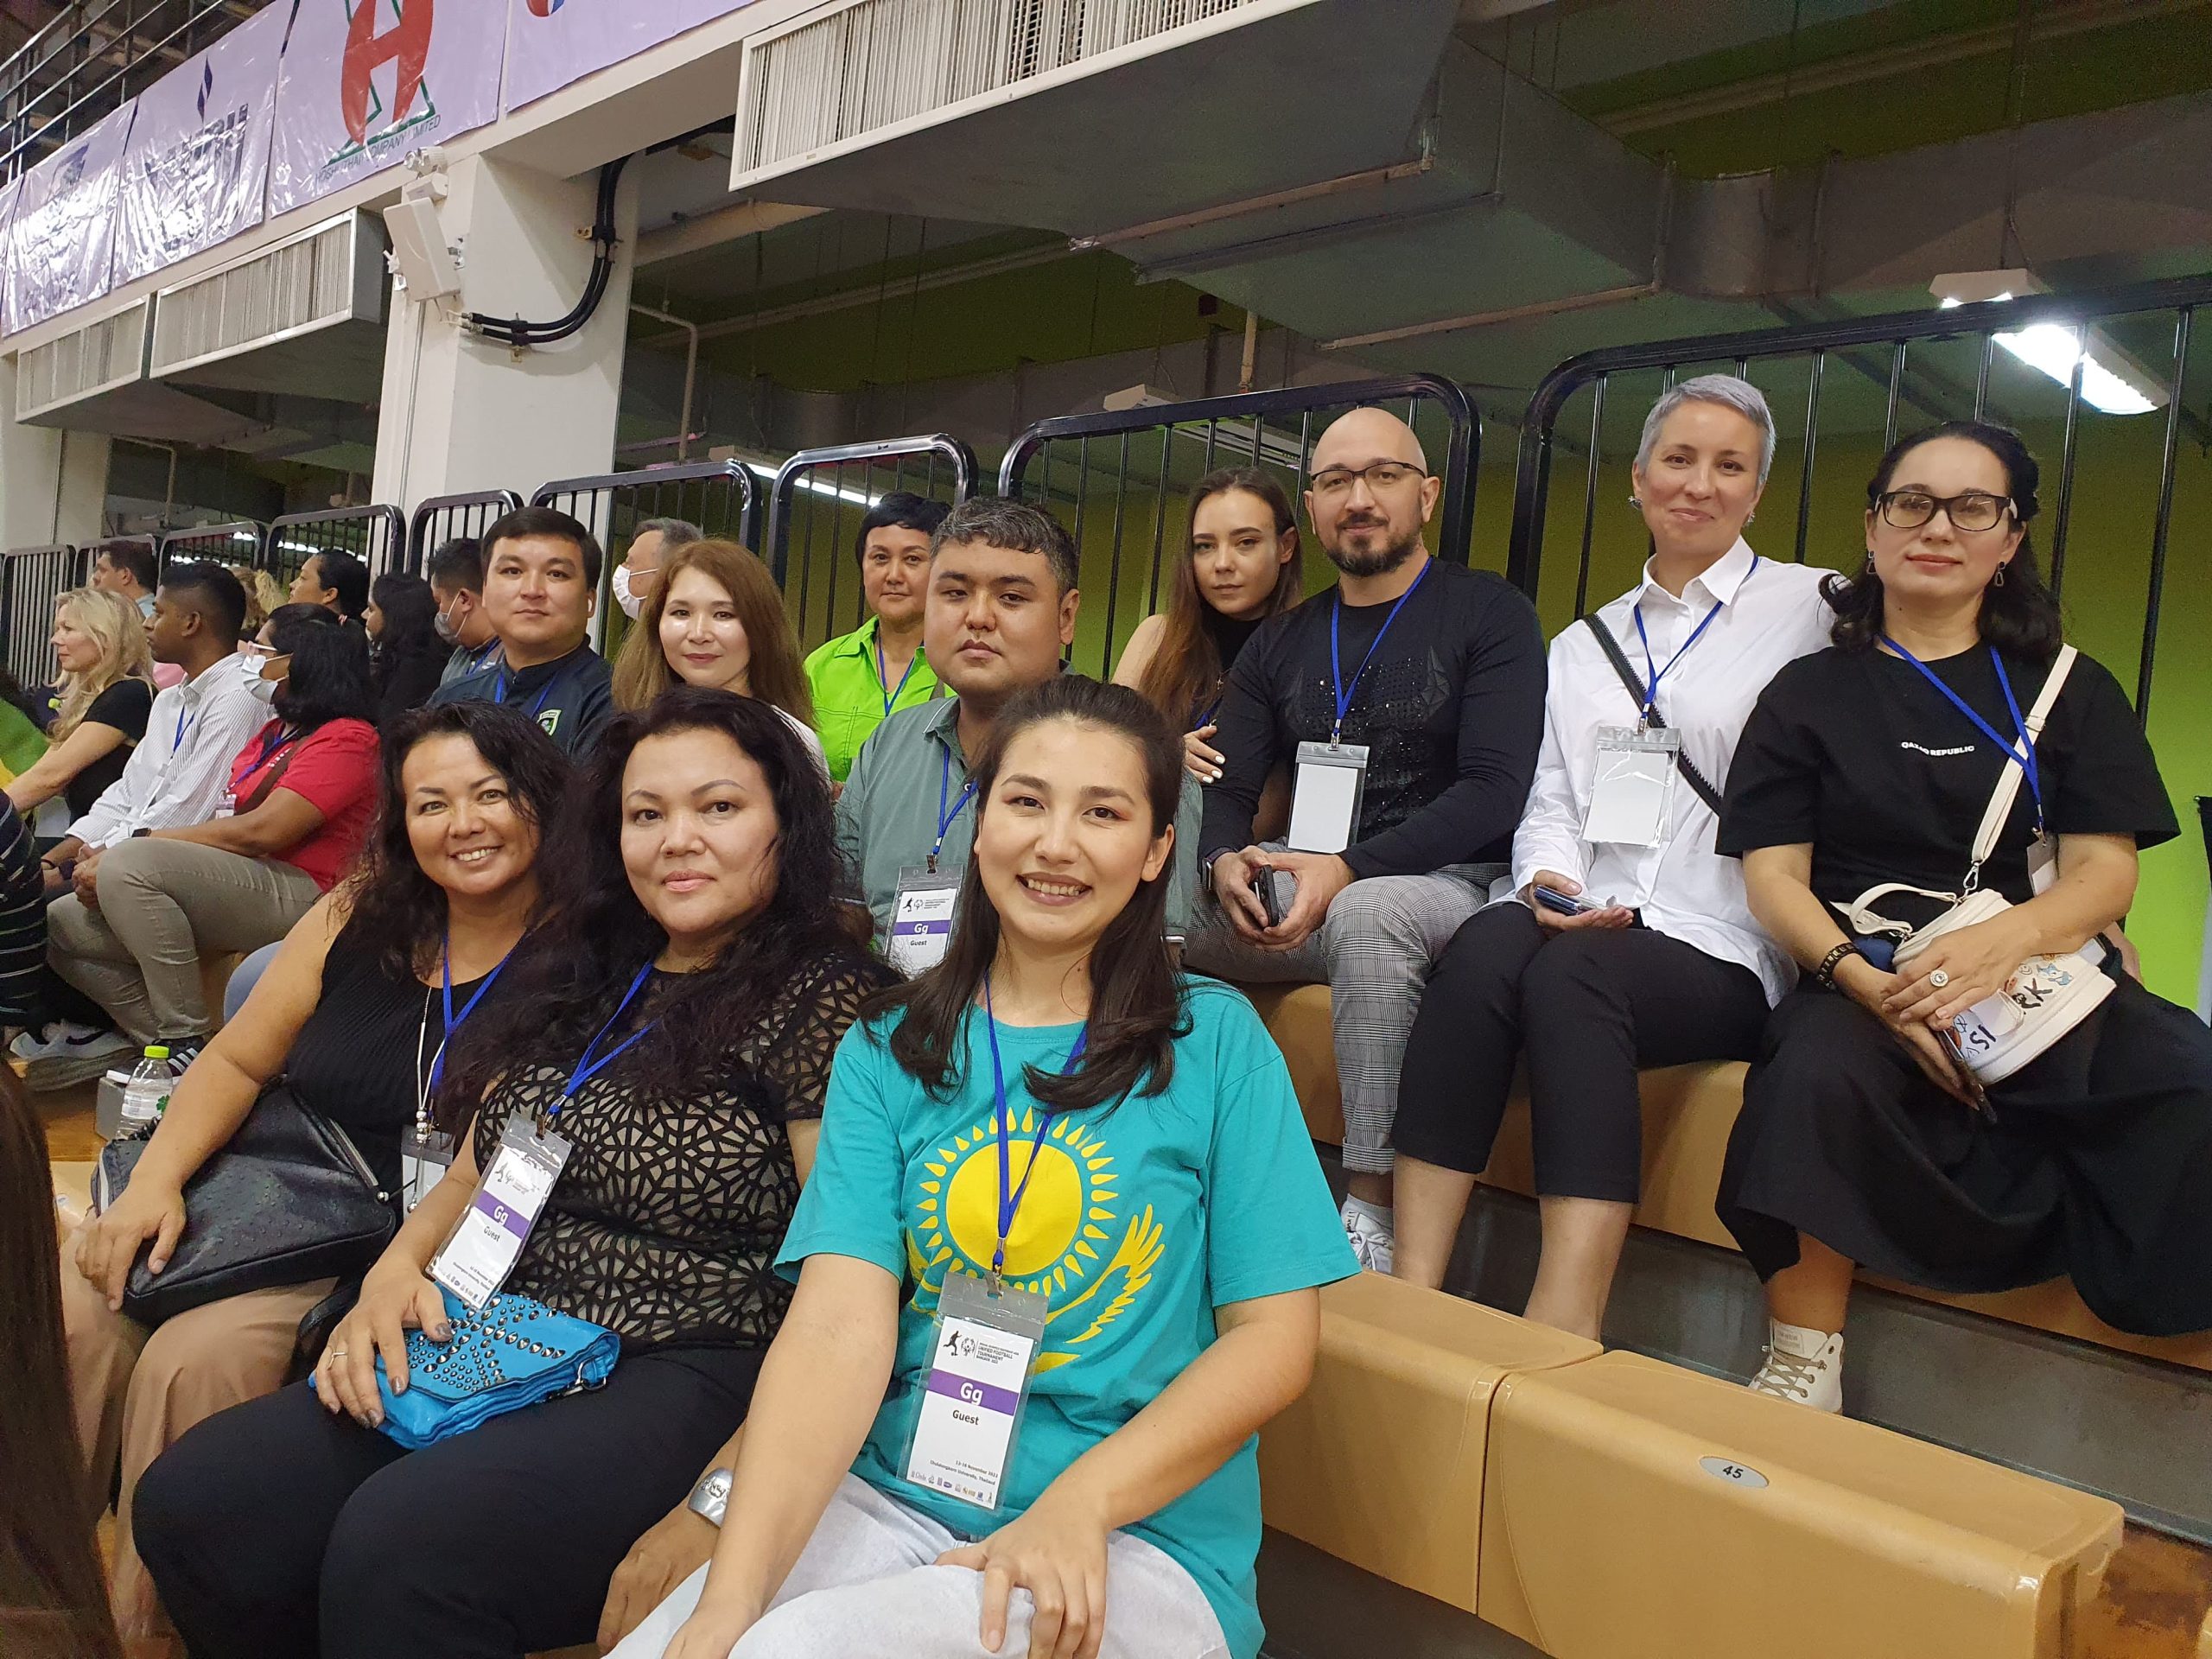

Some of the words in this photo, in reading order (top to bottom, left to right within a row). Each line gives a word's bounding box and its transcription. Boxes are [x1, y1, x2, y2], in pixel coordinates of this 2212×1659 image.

[1929, 745, 1975, 756] REPUBLIC
[914, 923, 929, 935] Gg
[493, 1205, 509, 1226] Gg
[483, 1225, 501, 1243] Guest
[960, 1382, 983, 1406] Gg
[952, 1409, 979, 1425] Guest
[1722, 1465, 1744, 1478] 45
